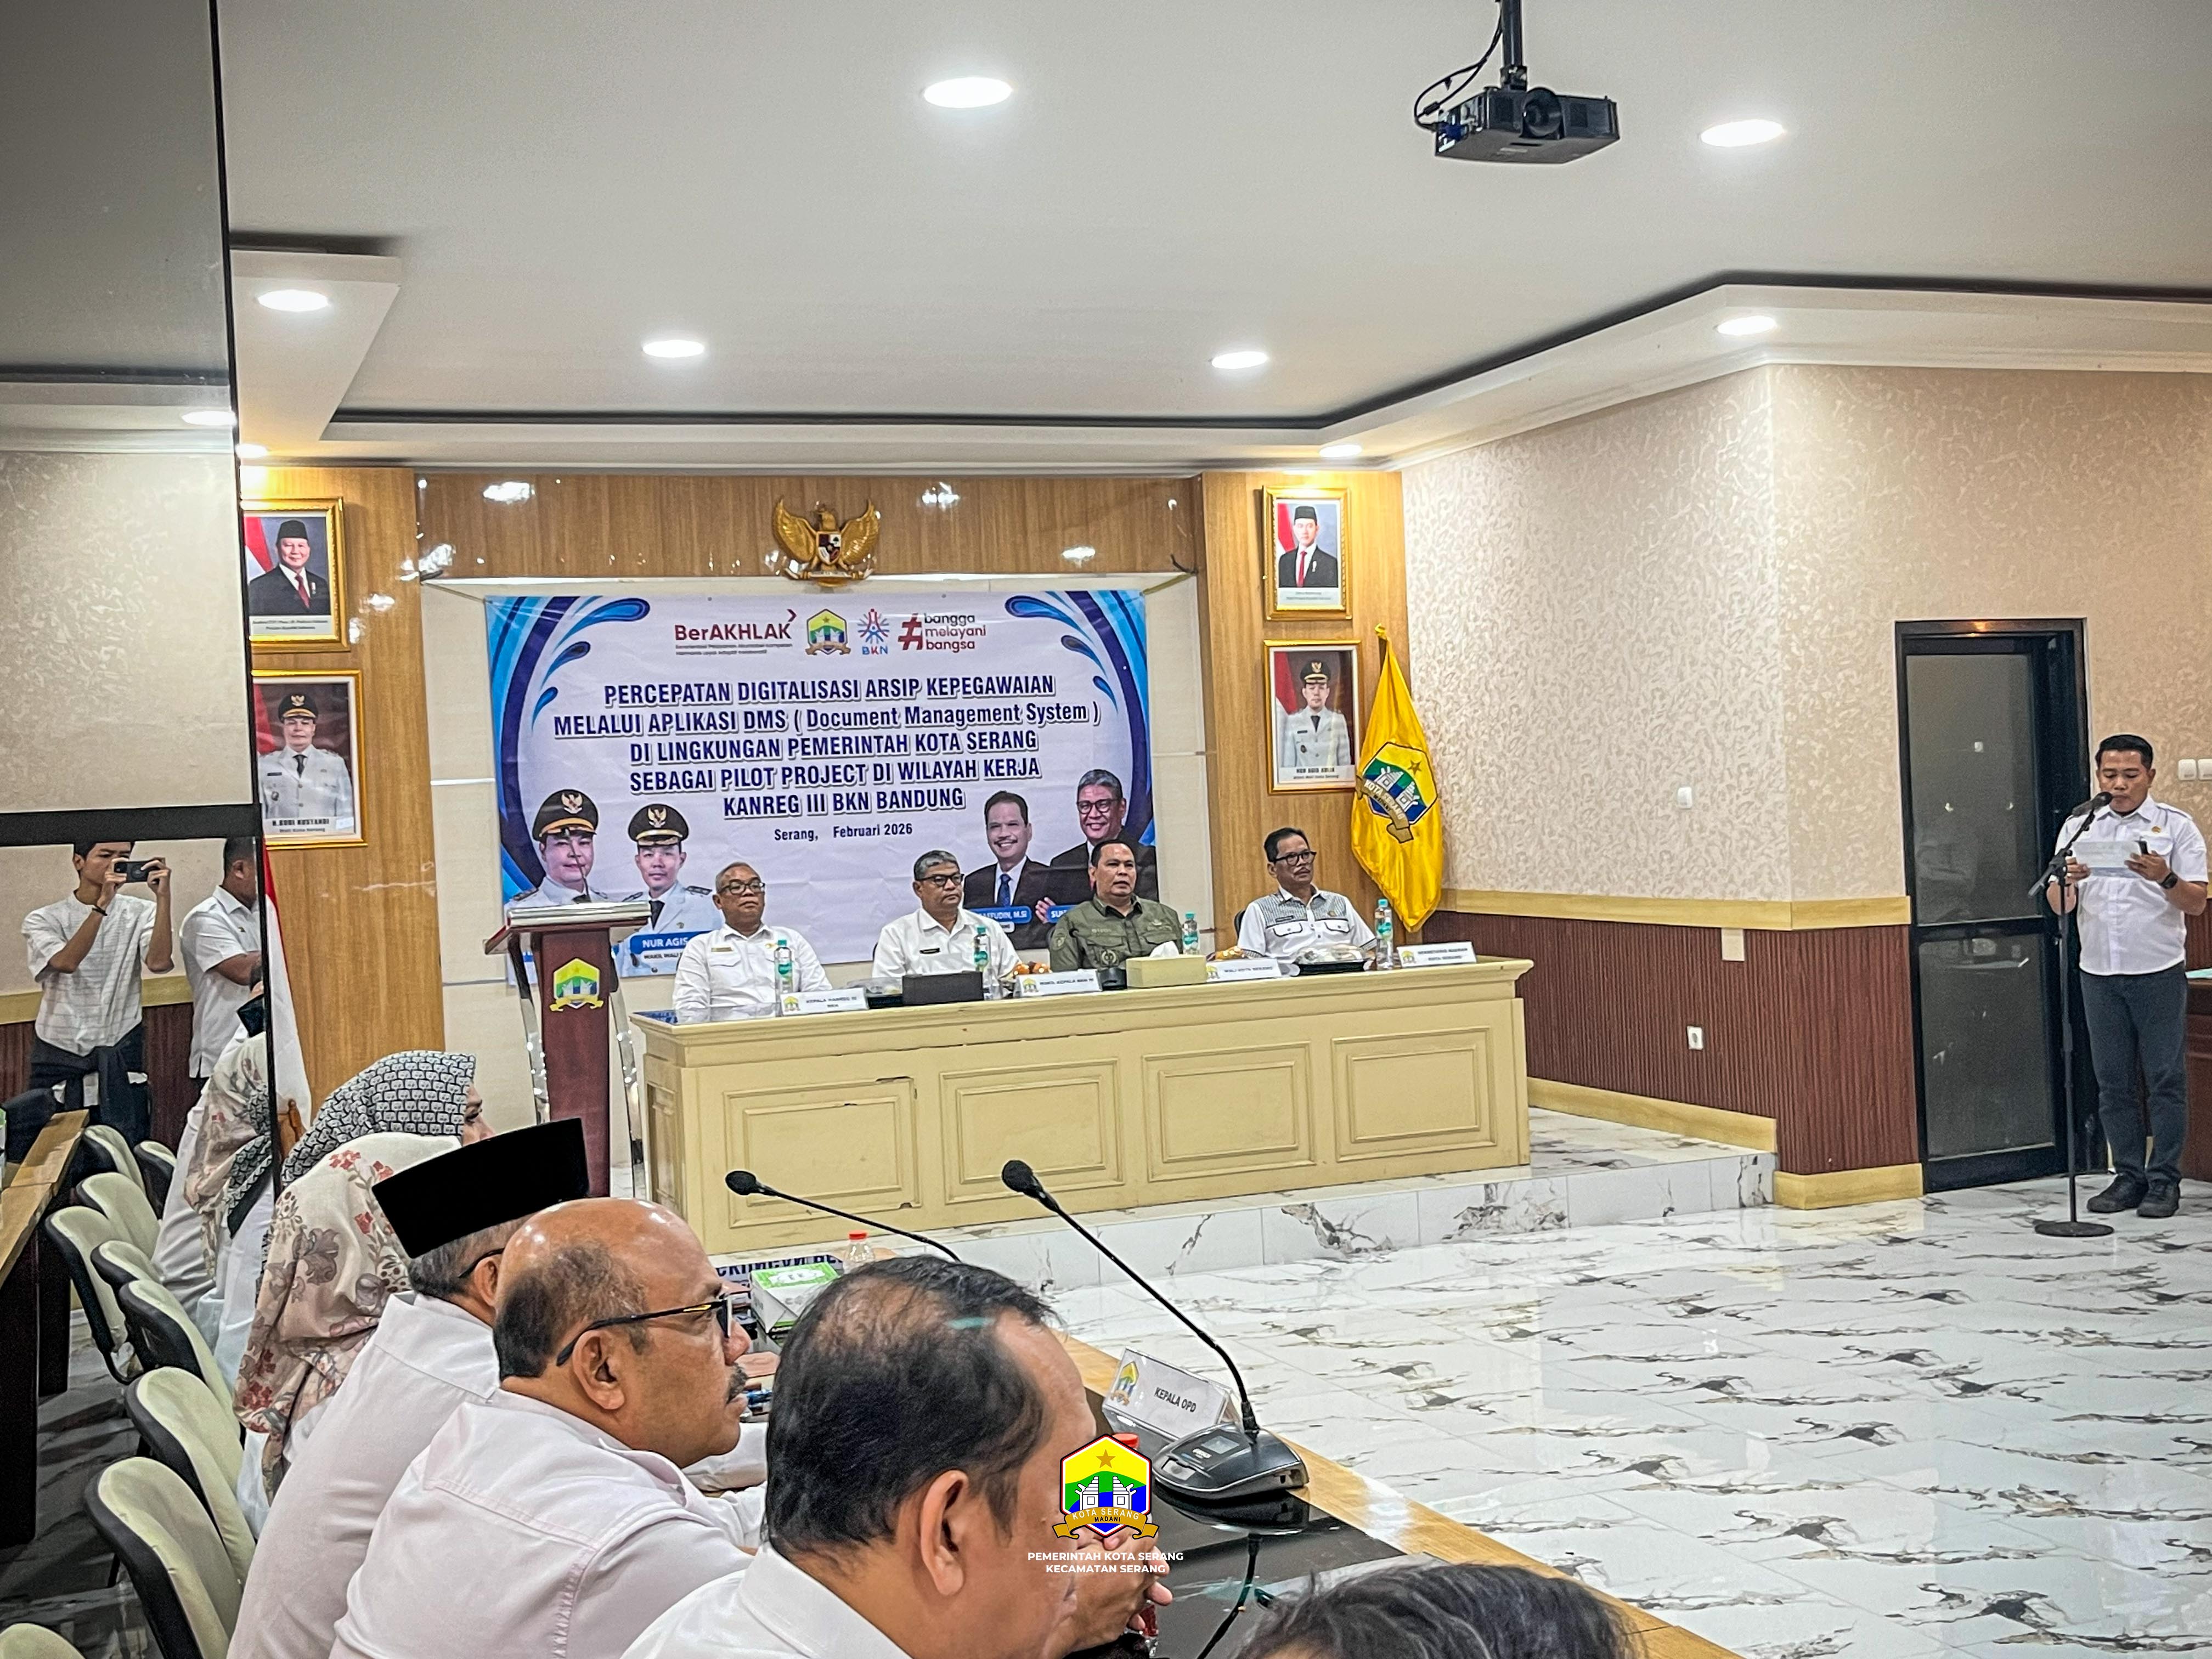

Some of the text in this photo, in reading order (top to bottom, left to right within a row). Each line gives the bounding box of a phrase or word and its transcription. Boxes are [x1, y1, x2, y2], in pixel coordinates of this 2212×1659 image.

[923, 613, 975, 627] bangga
[674, 623, 792, 640] BerAKHLAK
[925, 624, 986, 640] melayani
[862, 646, 888, 654] BKN
[926, 639, 975, 653] bangsa
[605, 675, 1053, 704] PERCEPATAN DIGITALISASI ARSIP KEPEGAWAIAN
[554, 714, 640, 736] MELALUI
[648, 712, 735, 732] APLIKASI
[744, 710, 786, 729] DMS
[807, 708, 898, 727] Document
[905, 704, 1020, 726] Management
[1027, 703, 1086, 724] System
[630, 730, 1036, 761] DI LINGKUNGAN PEMERINTAH KOTA SERANG
[630, 758, 1039, 791] SEBAGAI PILOT PROJECT DI WILAYAH KERJA
[724, 788, 963, 816] KANREG III BKN BANDUNG
[774, 823, 912, 842] Serang, Februari 2026
[642, 939, 664, 949] NUR
[1154, 1387, 1197, 1413] KEPALA OPD
